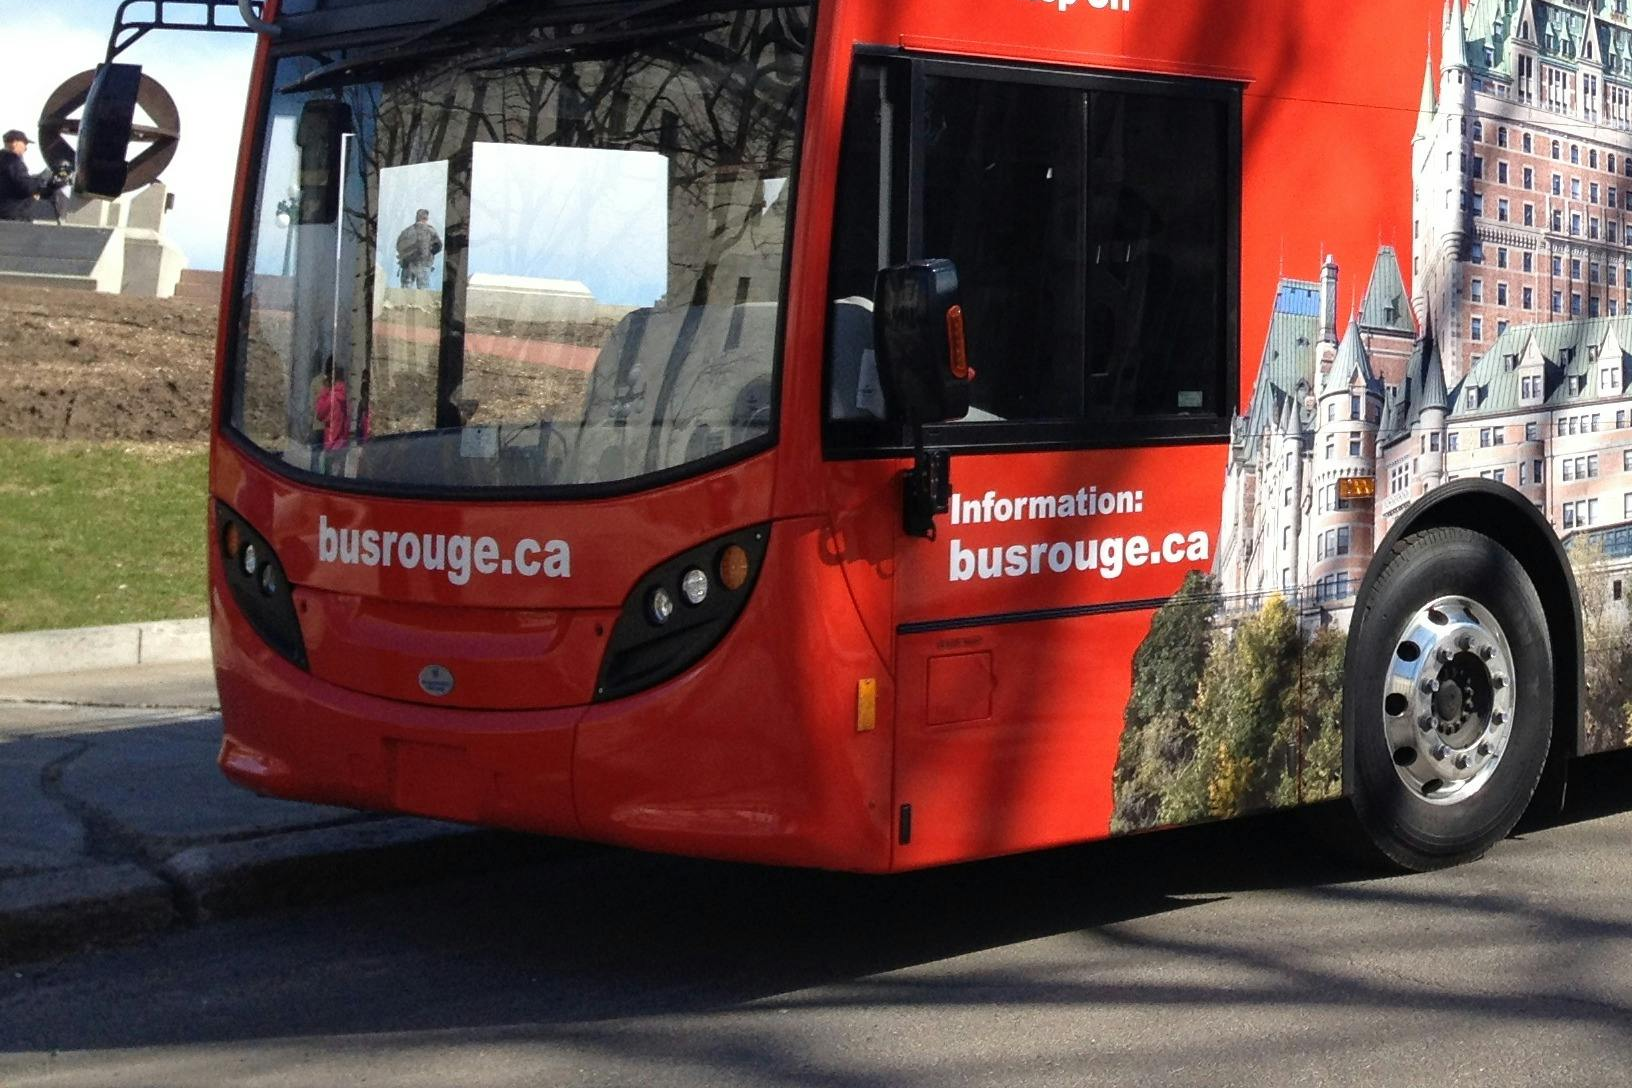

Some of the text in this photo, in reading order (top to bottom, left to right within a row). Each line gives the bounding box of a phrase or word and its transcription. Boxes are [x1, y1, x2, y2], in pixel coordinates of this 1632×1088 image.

[950, 485, 1143, 525] Information:
[318, 514, 572, 586] busrouge.ca
[949, 529, 1209, 582] busrouge.ca
